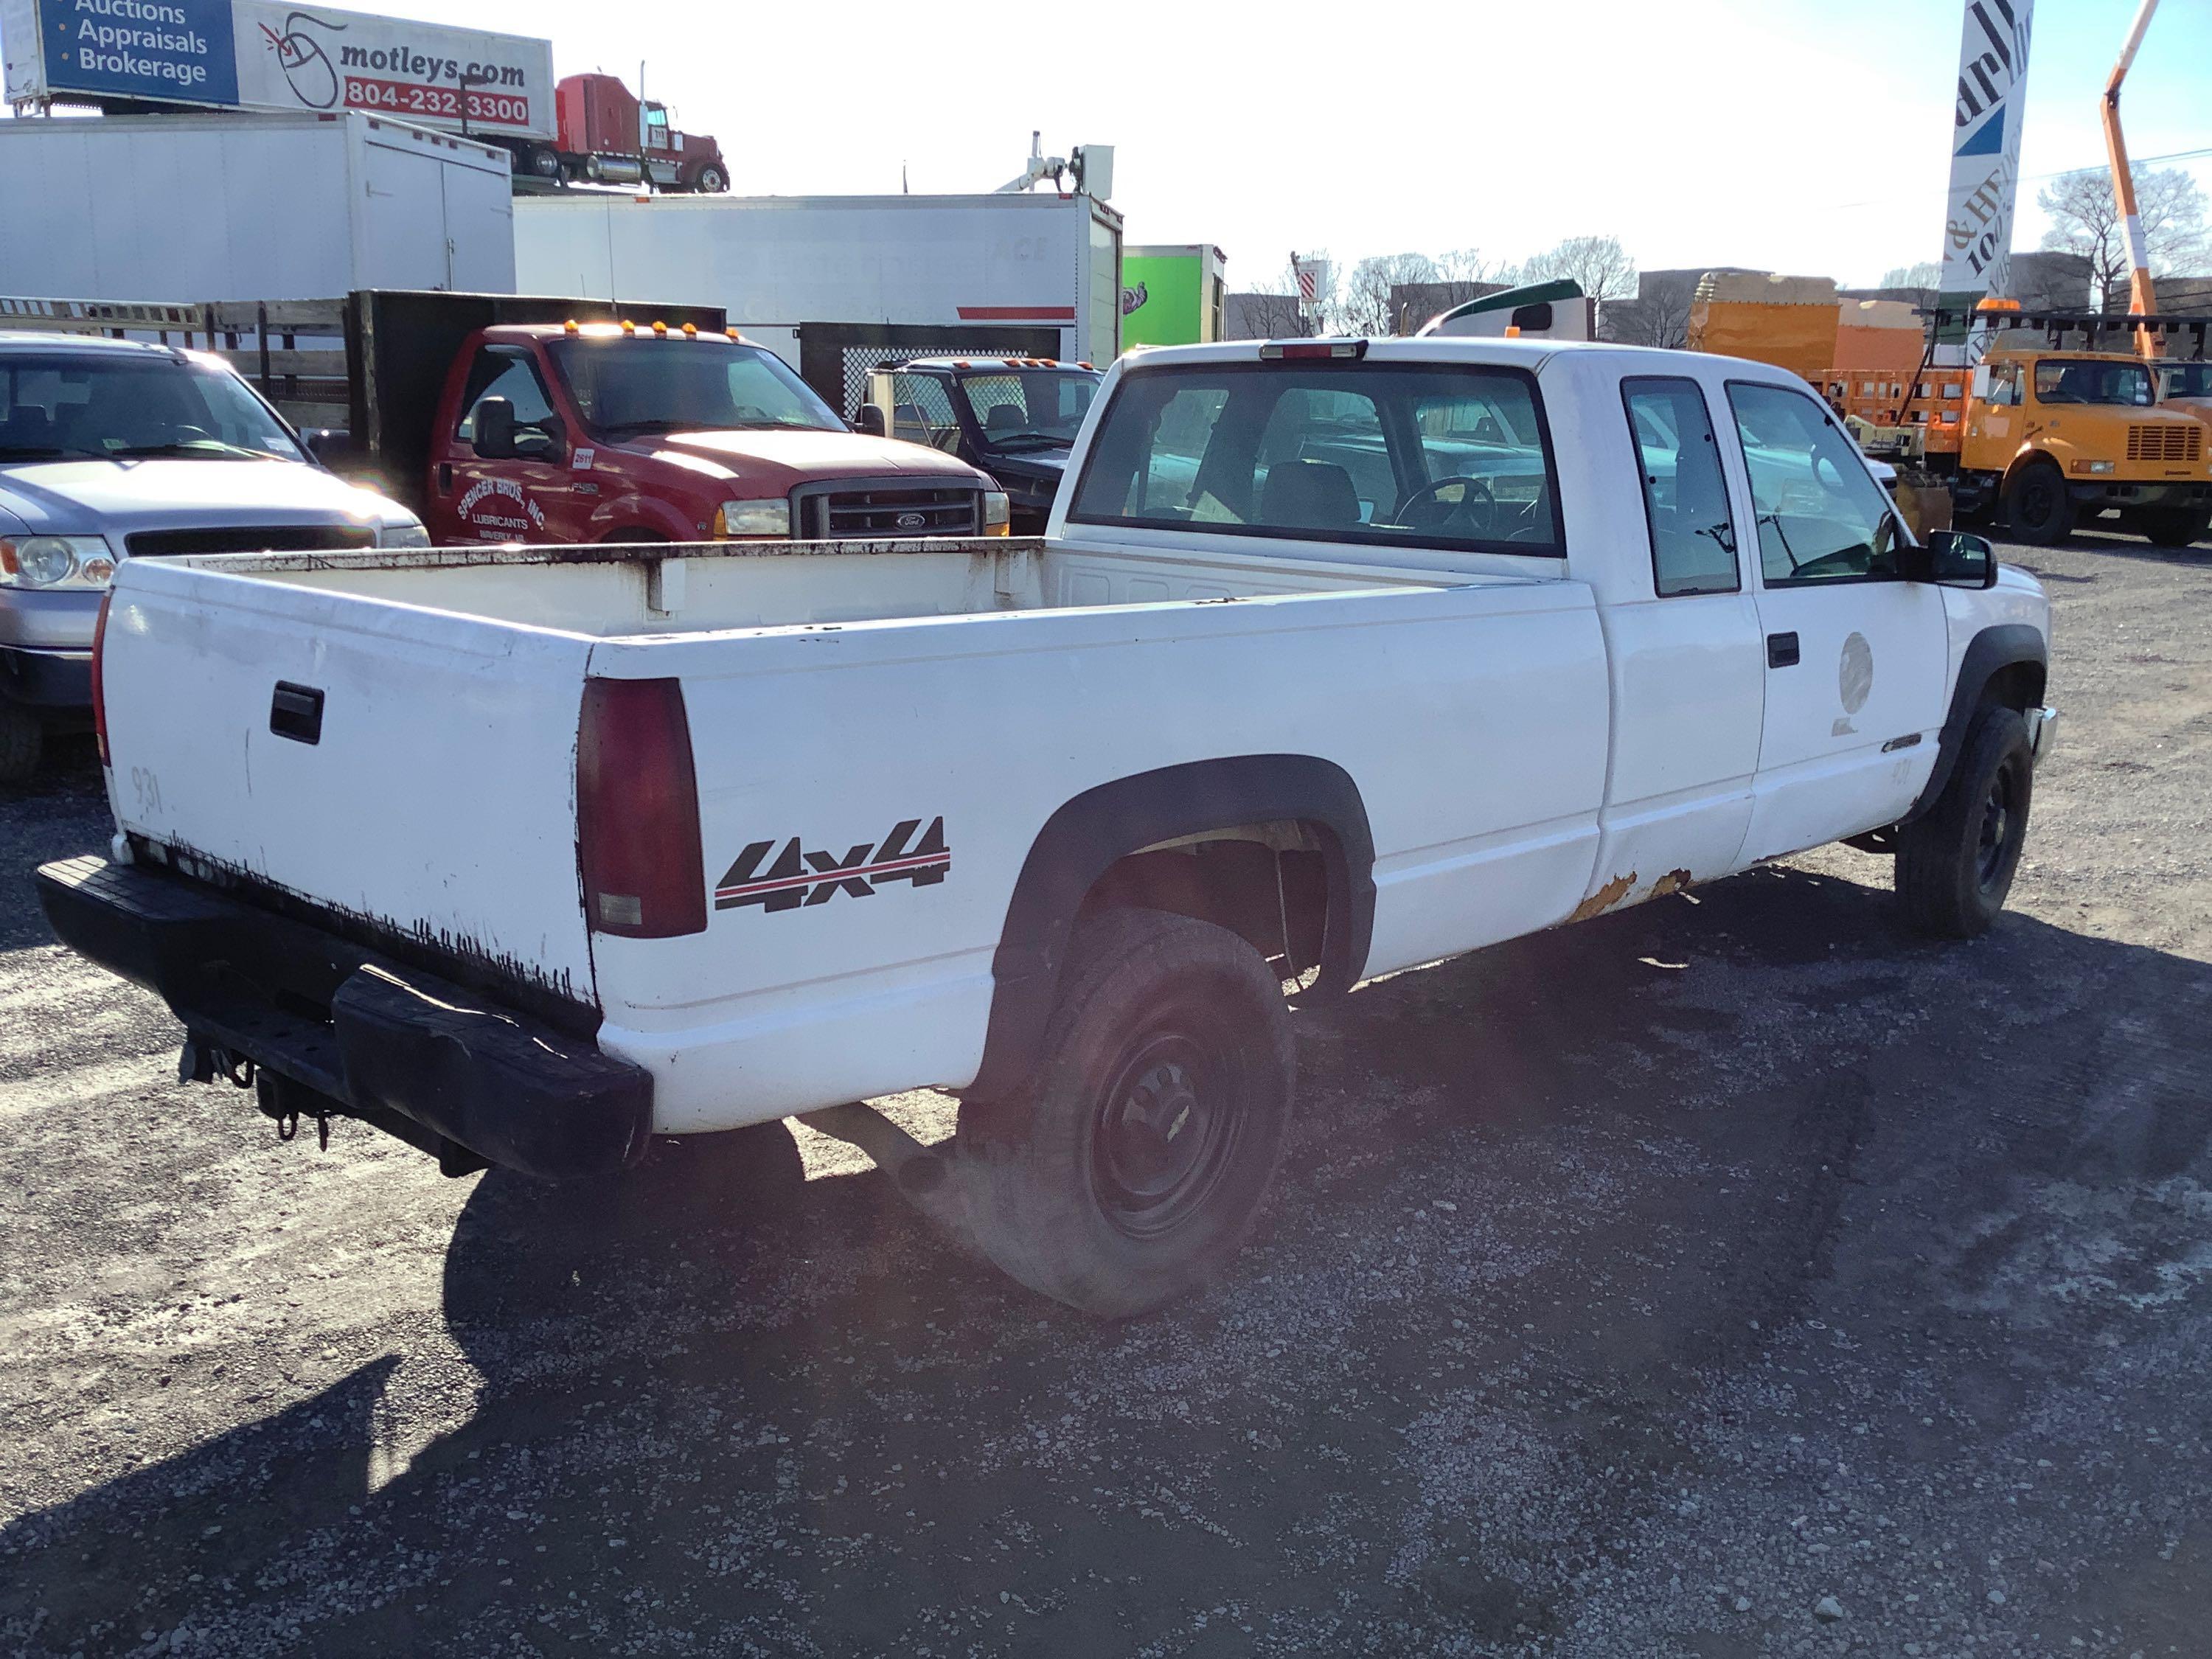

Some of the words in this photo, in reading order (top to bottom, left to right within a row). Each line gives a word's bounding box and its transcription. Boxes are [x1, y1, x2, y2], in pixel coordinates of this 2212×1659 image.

[74, 0, 186, 24] Auctions
[77, 18, 208, 55] Appraisals
[79, 47, 206, 86] Brokerage
[348, 81, 527, 121] 804-232-3300
[457, 476, 494, 520] SPENCER
[472, 513, 529, 529] LUBRICANTS
